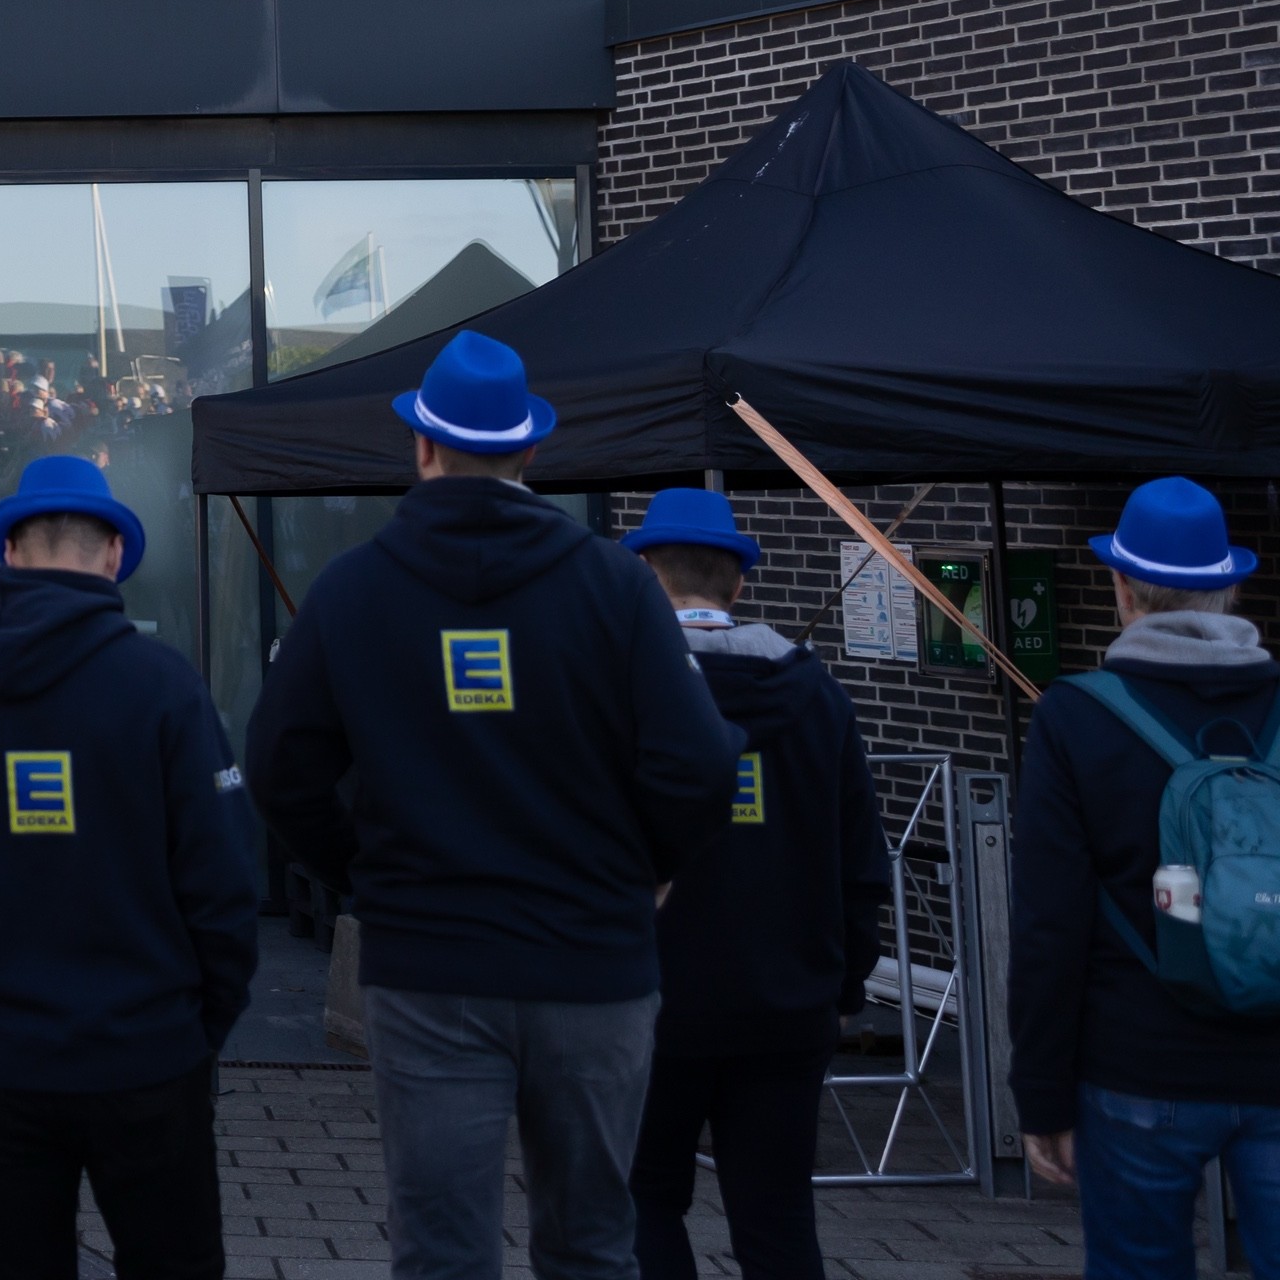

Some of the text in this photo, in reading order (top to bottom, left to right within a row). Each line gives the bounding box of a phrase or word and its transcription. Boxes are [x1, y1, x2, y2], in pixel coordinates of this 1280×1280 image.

[941, 564, 969, 580] AED
[1013, 636, 1043, 649] AED
[454, 693, 506, 705] EDEKA
[731, 807, 758, 817] EKA
[16, 815, 69, 826] EDEKA
